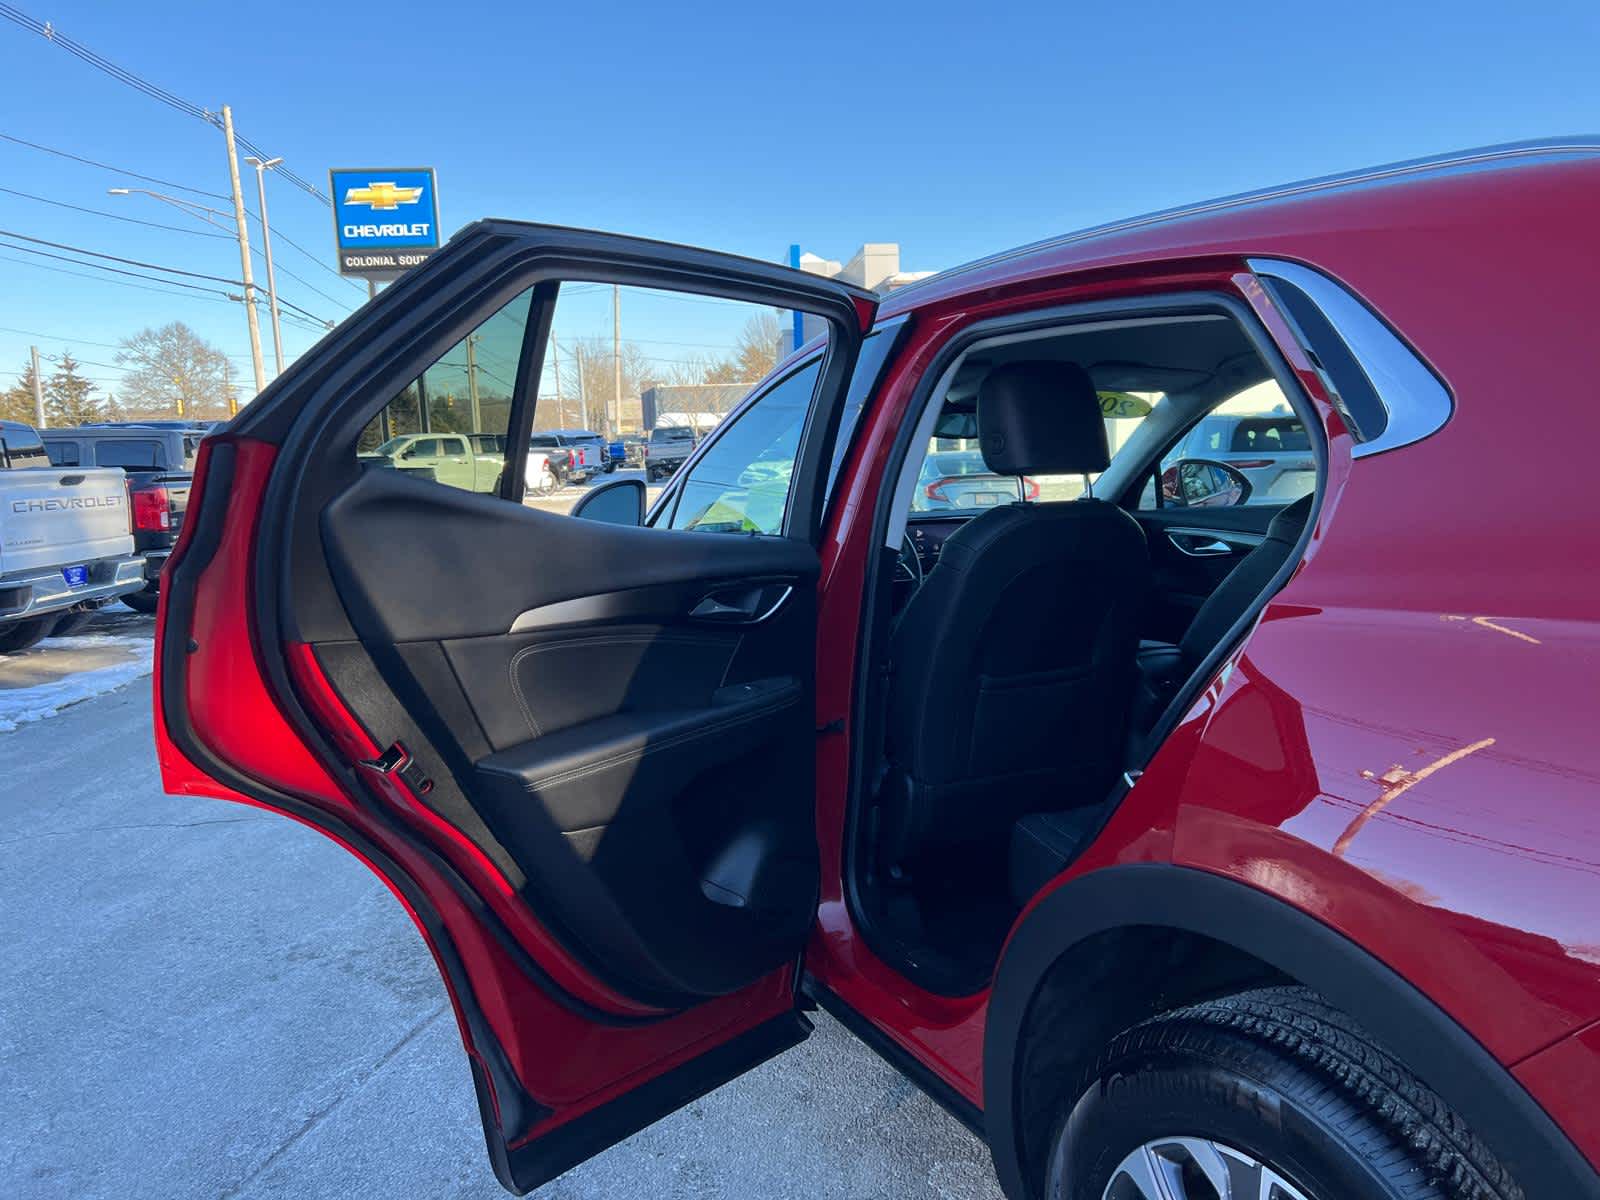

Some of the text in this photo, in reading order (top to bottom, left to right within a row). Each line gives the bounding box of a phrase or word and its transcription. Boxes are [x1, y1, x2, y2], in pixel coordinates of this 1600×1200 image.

[344, 223, 430, 238] CHEVROLET
[345, 255, 428, 267] COLONIAL SOUT
[13, 496, 123, 513] CHEVROLET
